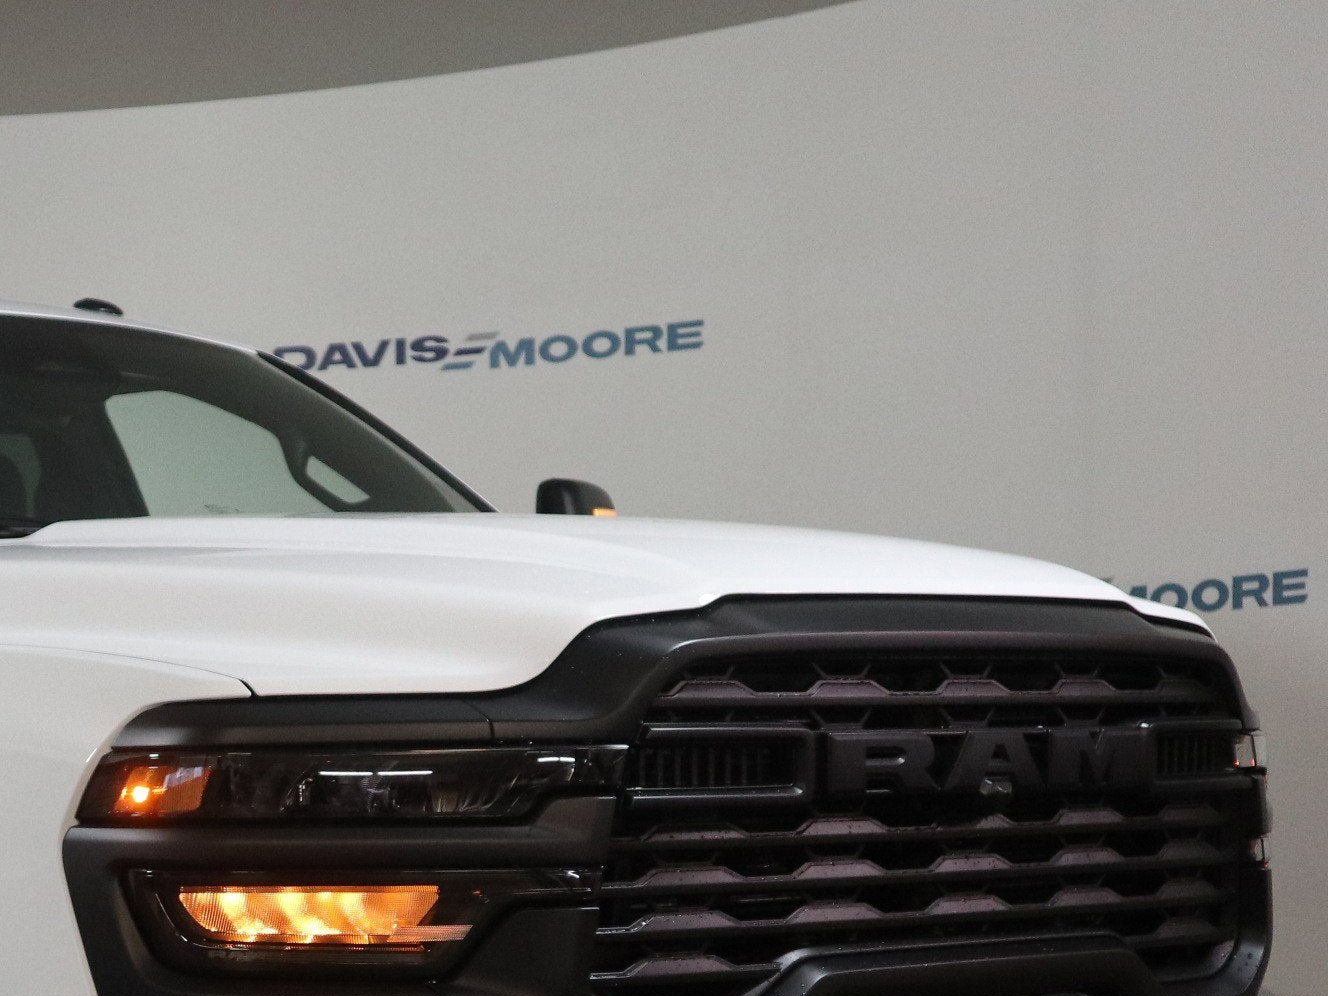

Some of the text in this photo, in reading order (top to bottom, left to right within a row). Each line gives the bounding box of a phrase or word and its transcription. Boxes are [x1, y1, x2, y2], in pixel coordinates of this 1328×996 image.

[489, 319, 704, 369] MOORE
[1129, 568, 1308, 612] OORE
[828, 726, 1156, 795] RAM
